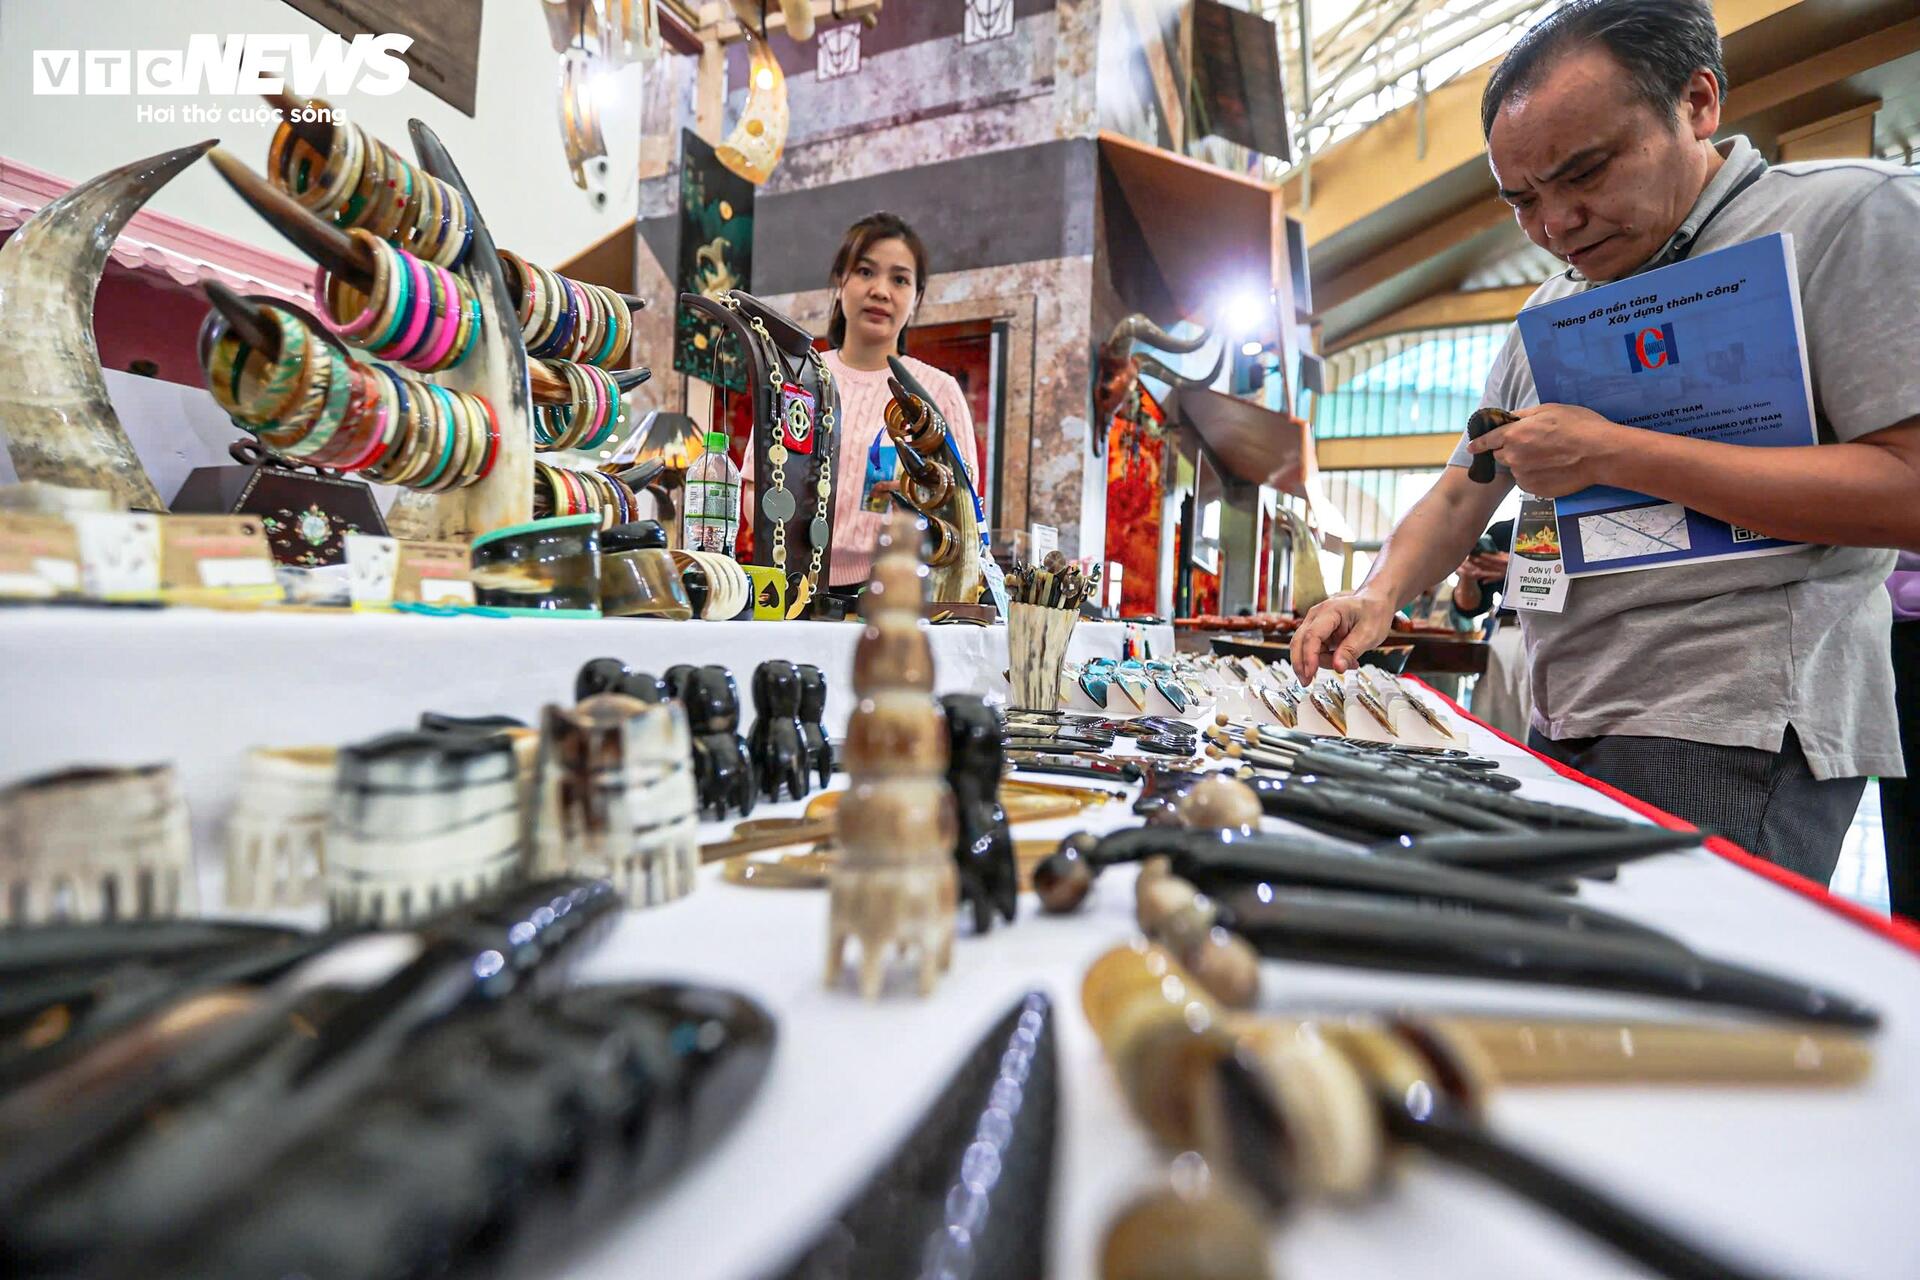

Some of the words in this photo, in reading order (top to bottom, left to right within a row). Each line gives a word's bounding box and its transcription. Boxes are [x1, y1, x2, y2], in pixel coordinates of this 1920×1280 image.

[1608, 313, 1631, 326] Xây
[1633, 305, 1664, 319] dựng
[1666, 292, 1703, 309] thành
[1660, 407, 1680, 418] VIỆT
[1681, 403, 1703, 413] NAM
[1704, 421, 1738, 433] HANIKO
[1739, 416, 1758, 426] VIỆT
[1760, 412, 1782, 423] NAM
[1528, 565, 1543, 574] ĐƠN
[1544, 566, 1552, 576] VỊ
[1519, 575, 1542, 585] TRƯNG
[1542, 575, 1557, 586] BÀY
